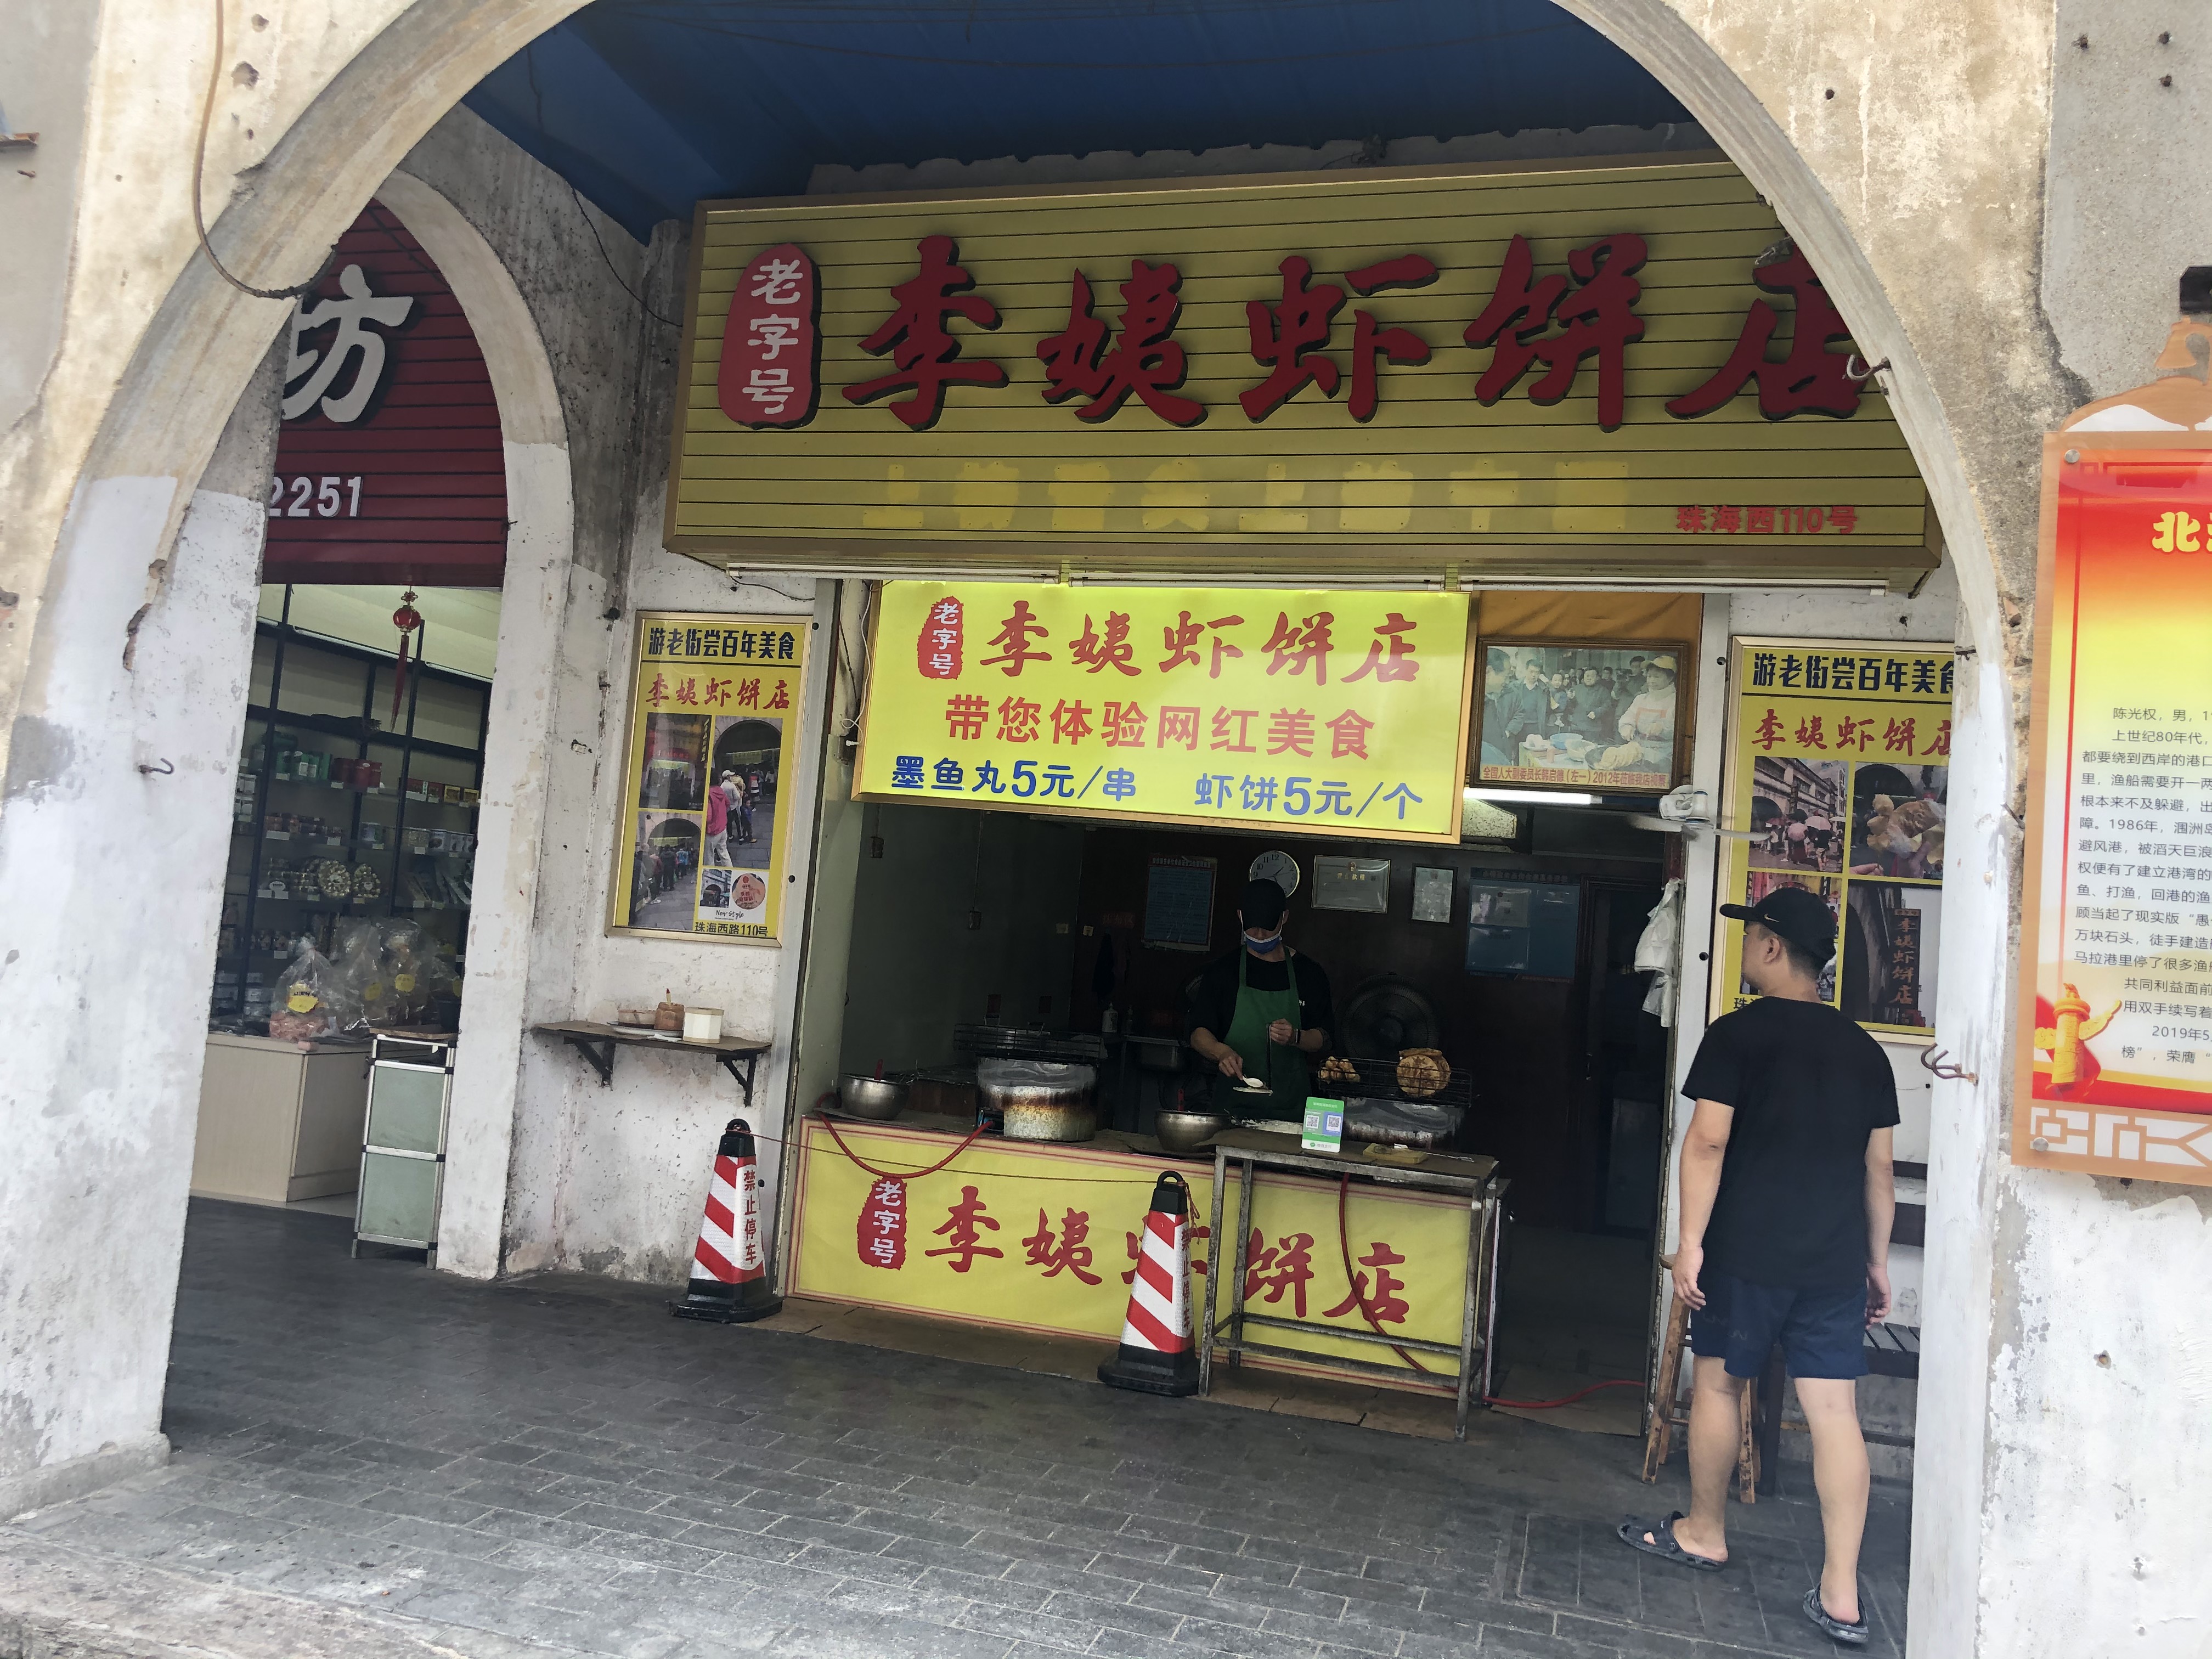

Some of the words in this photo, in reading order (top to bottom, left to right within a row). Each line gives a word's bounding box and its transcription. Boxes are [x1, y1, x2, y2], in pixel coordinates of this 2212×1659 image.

[743, 258, 803, 415] 老字号
[842, 233, 1864, 432] 李姨虾饼店
[1676, 505, 1857, 534] 珠海西110号
[2152, 511, 2212, 552] 北
[648, 627, 795, 660] 游老街尝百年美食
[928, 601, 958, 676] 老字号
[979, 600, 1420, 685] 李姨虾饼店
[645, 673, 790, 710] 李姨虾饼店
[945, 693, 1375, 759] 带您体验网红美食
[2113, 707, 2212, 722] 陈光权，男，1
[890, 755, 1137, 802] 墨鱼丸5元/串
[1195, 773, 1423, 821] 虾饼5元/个
[695, 922, 768, 936] 珠海西路110号
[2075, 906, 2212, 927] 顾当起了现实版“愚
[2075, 929, 2212, 950] 万块石头，徒手建造
[2152, 1025, 2212, 1042] 2019年5
[744, 1170, 757, 1264] 禁止停车
[869, 1180, 901, 1265] 老字号
